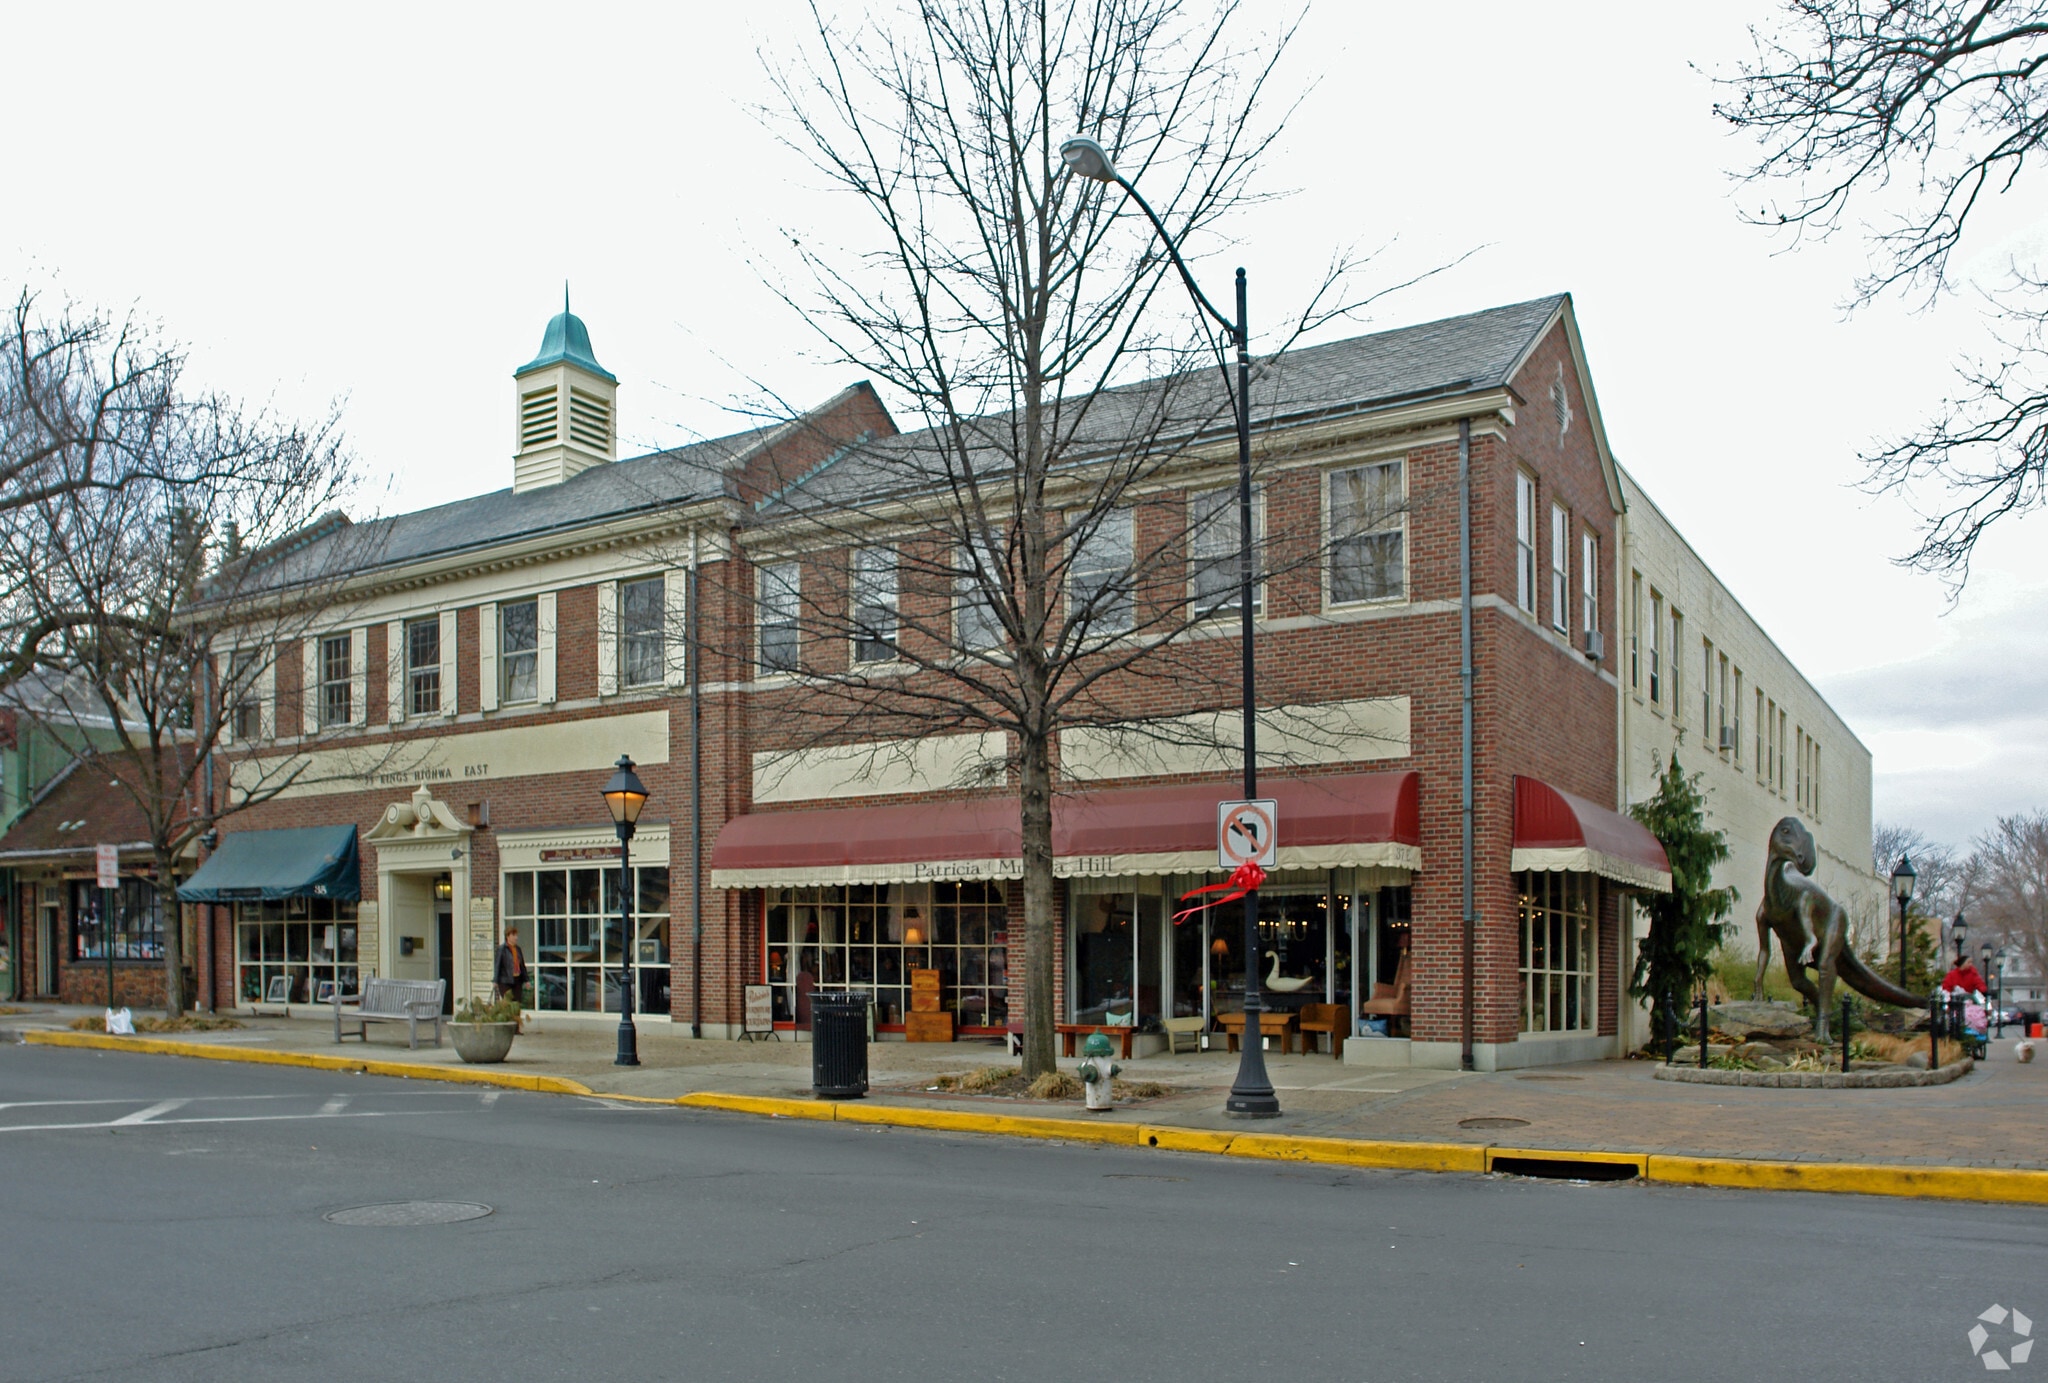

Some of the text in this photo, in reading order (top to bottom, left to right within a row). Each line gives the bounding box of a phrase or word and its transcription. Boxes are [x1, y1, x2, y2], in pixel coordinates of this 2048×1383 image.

[380, 772, 408, 785] KINGS
[414, 768, 452, 781] HIGHWA
[464, 764, 488, 776] EAST
[914, 862, 981, 878] Patricia
[1078, 857, 1112, 872] Hill
